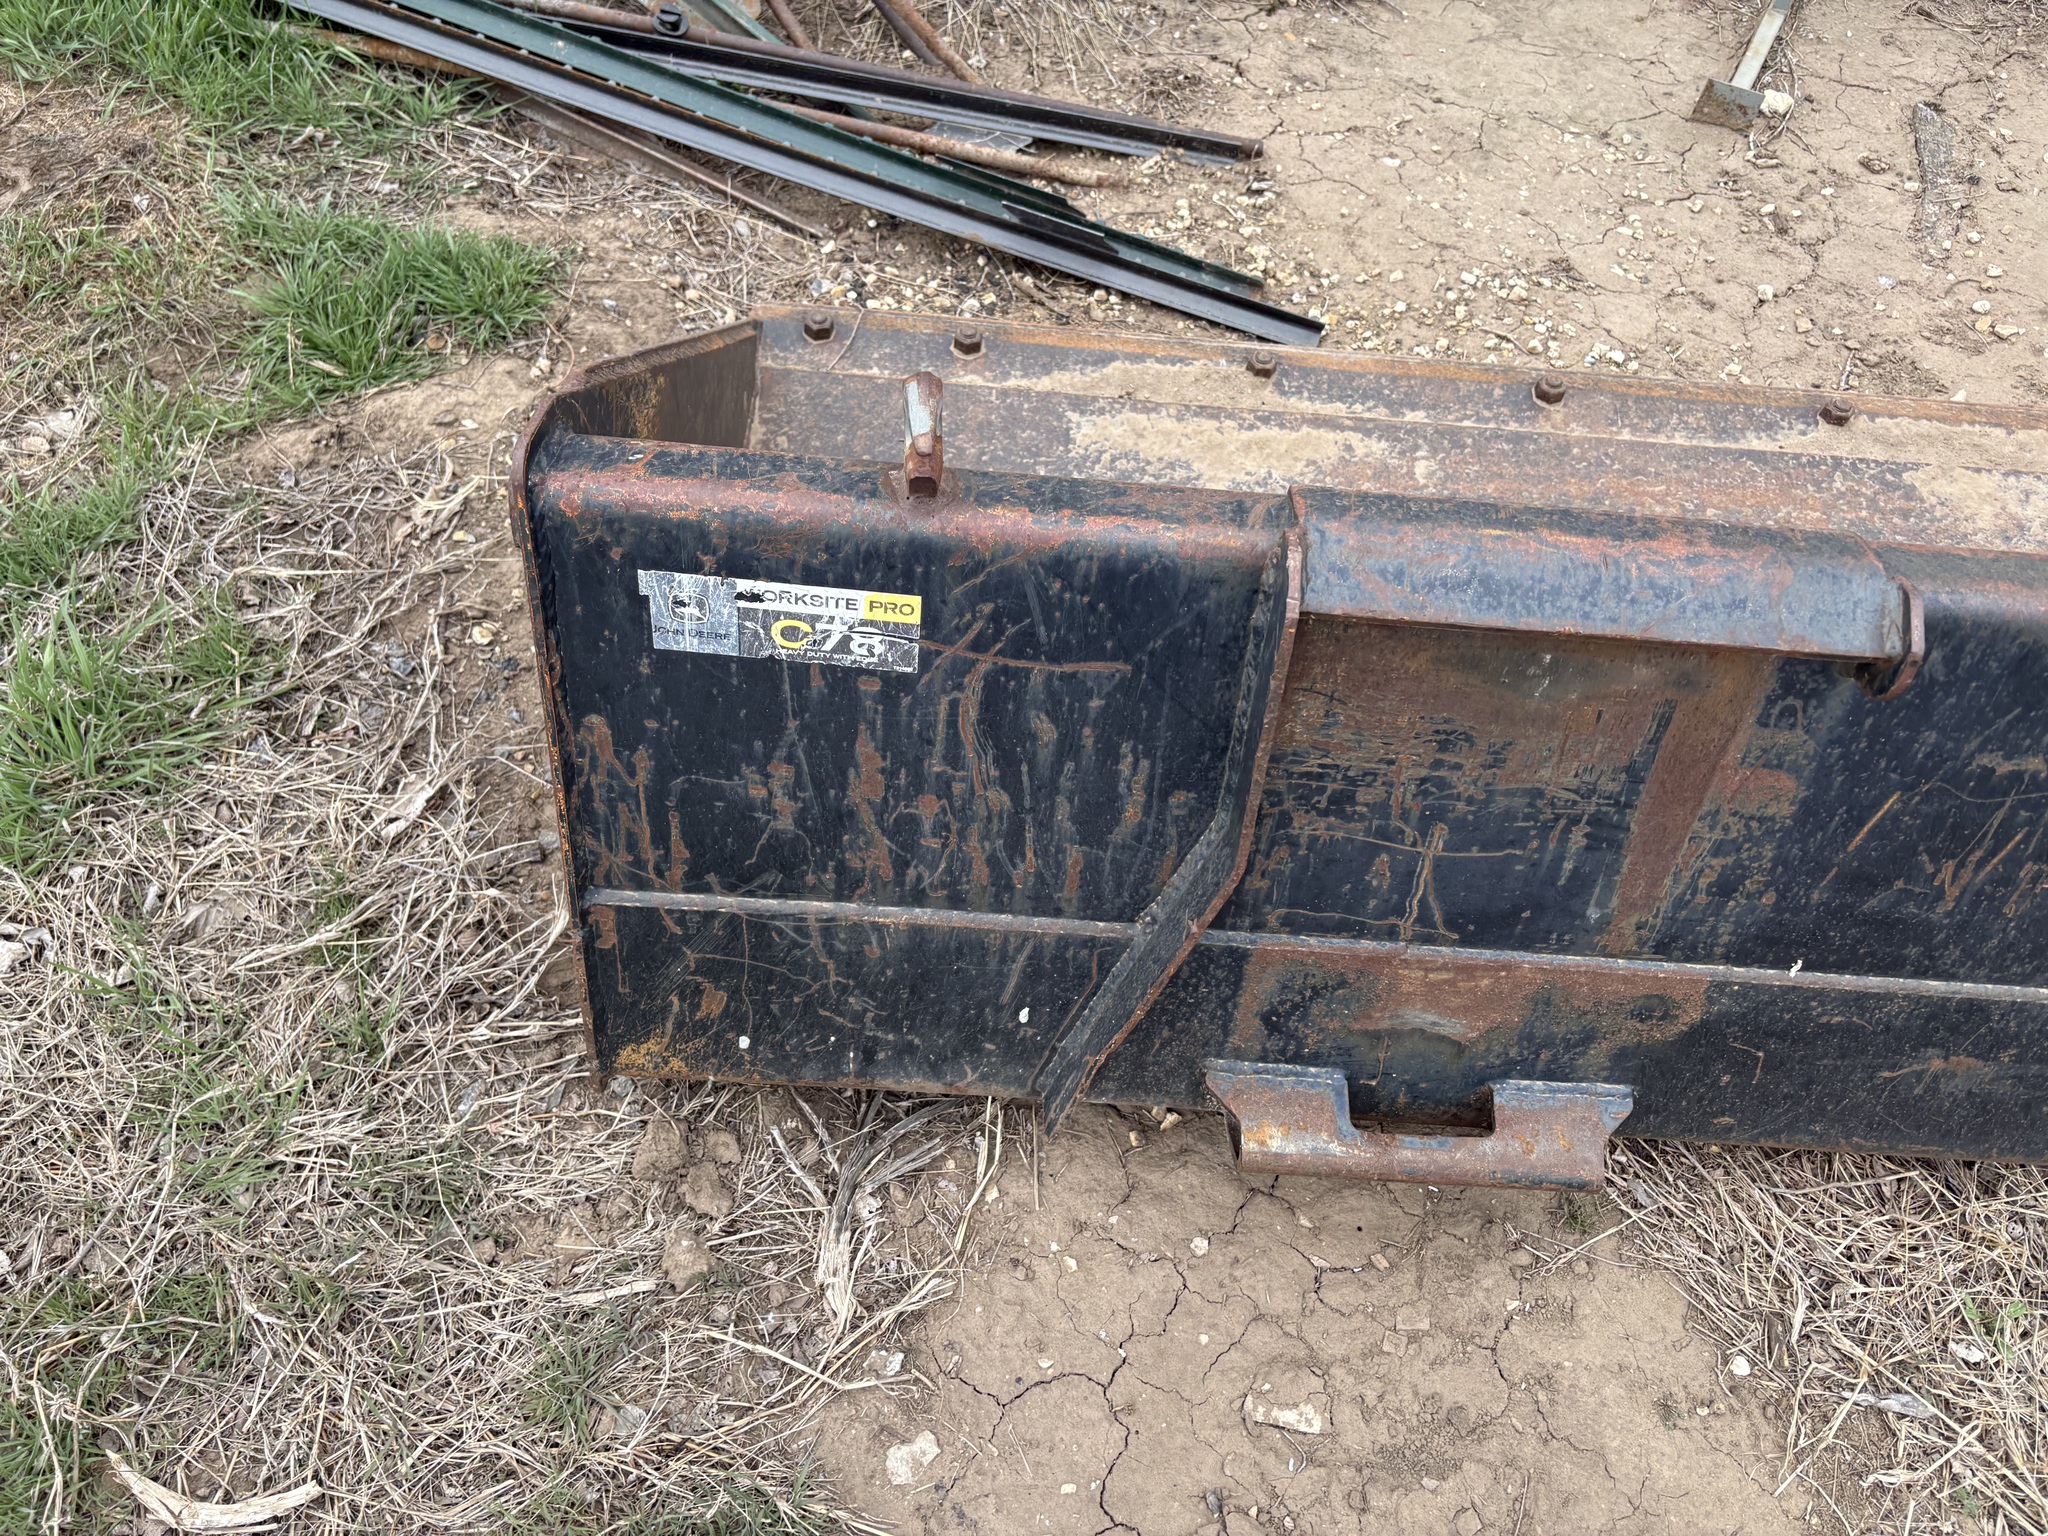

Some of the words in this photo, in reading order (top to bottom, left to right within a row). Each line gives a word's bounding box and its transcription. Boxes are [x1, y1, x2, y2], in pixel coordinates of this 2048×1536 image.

[744, 587, 858, 611] ORKSITE
[869, 600, 915, 616] PRO
[653, 624, 685, 636] JOHN
[771, 620, 884, 657] C78
[775, 648, 805, 656] HEAVY
[807, 651, 831, 659] DUTY
